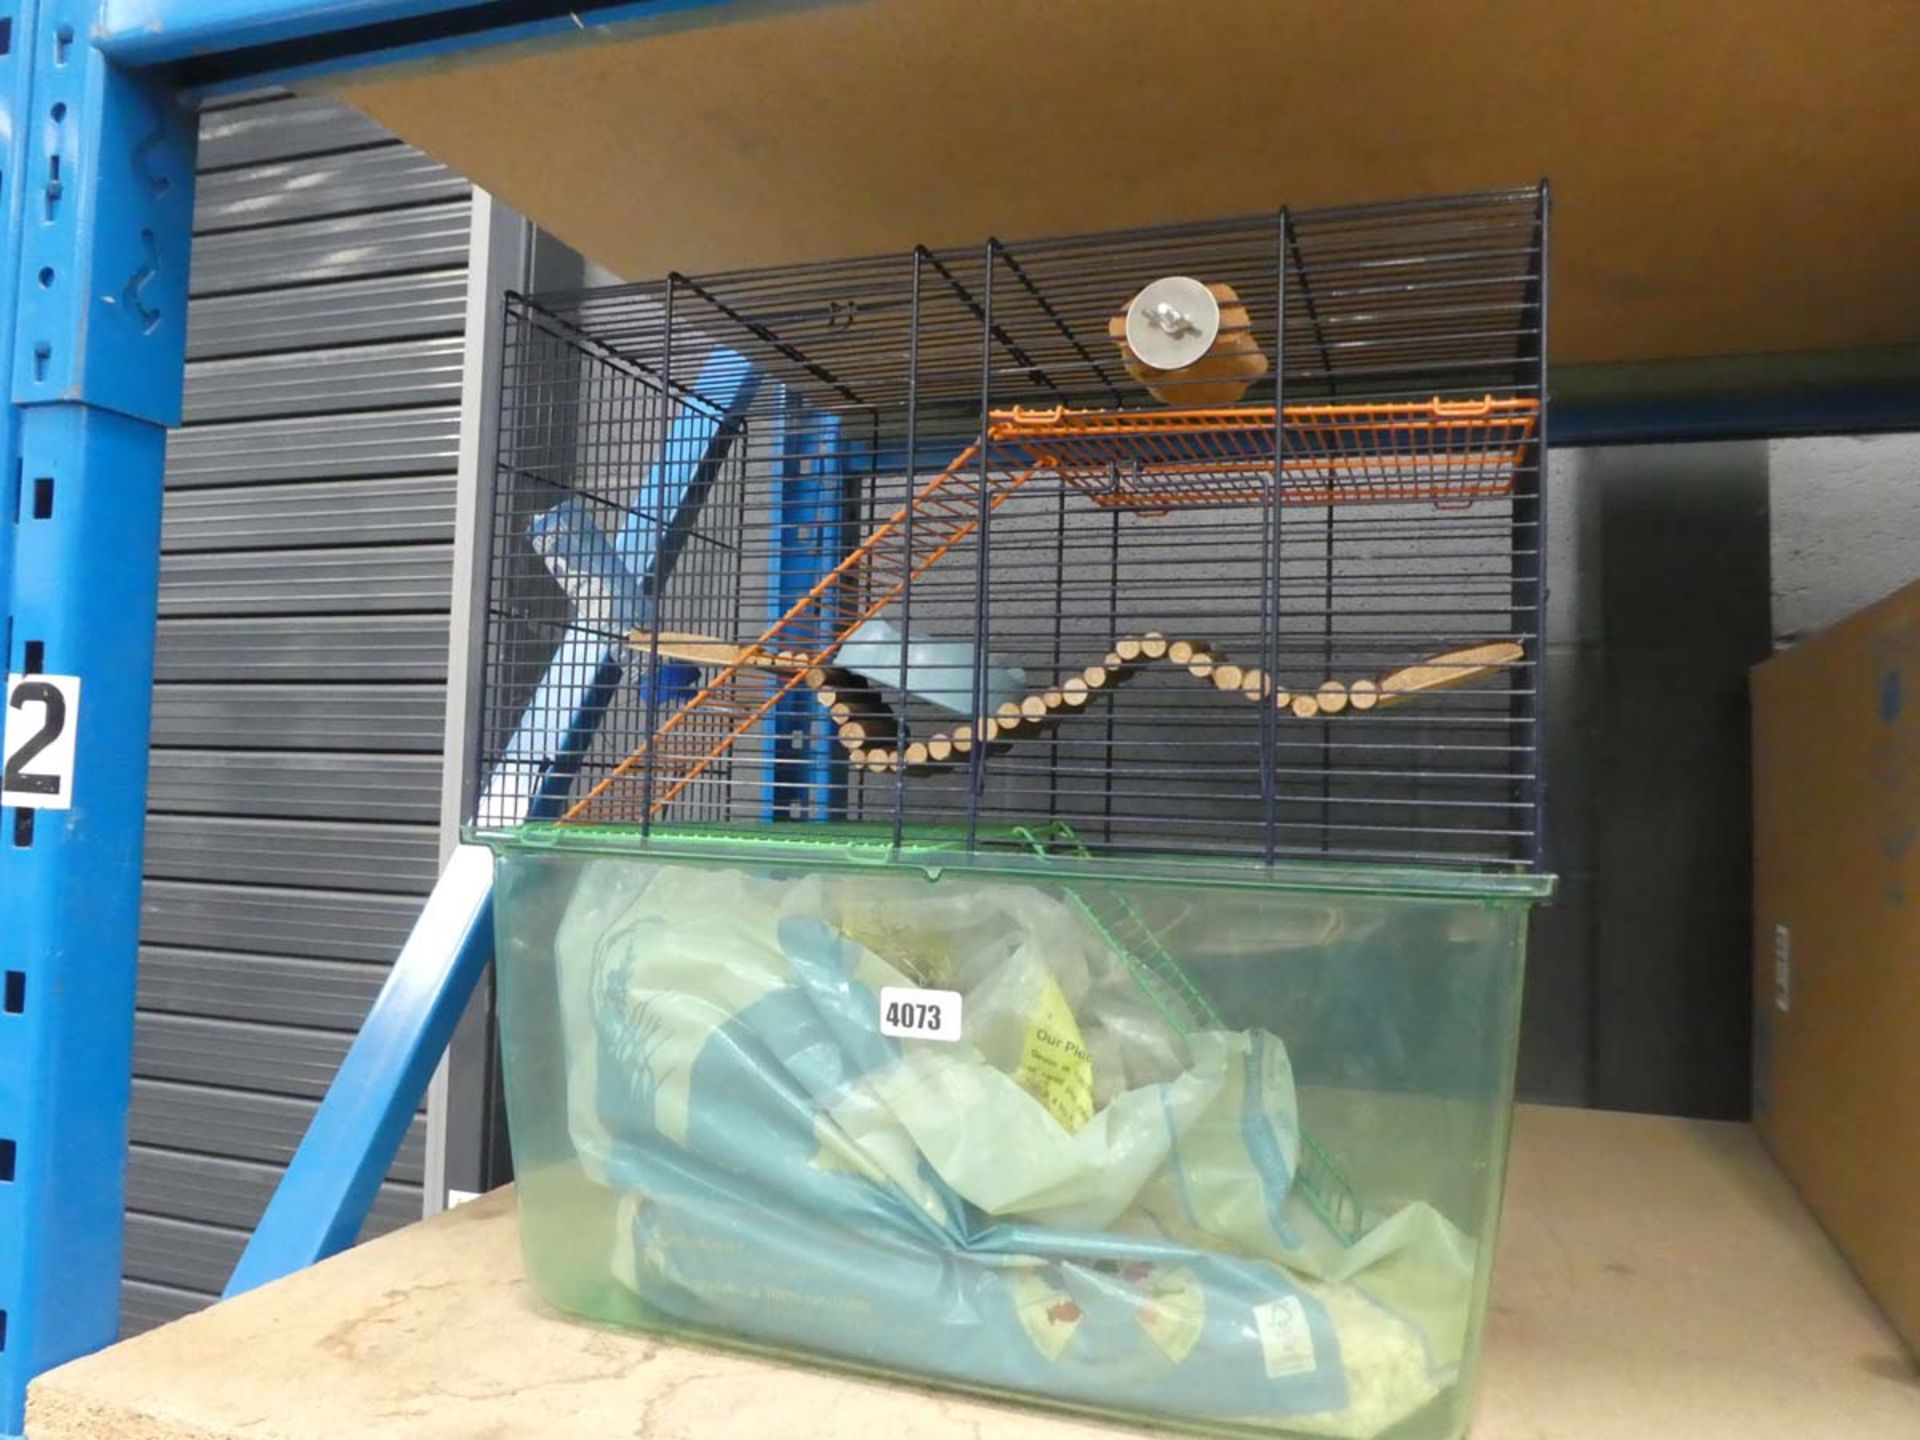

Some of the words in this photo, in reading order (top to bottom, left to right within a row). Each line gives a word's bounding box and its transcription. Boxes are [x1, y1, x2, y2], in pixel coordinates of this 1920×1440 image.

[4, 681, 66, 795] 2
[886, 1001, 942, 1031] 4073
[1036, 1028, 1063, 1048] Our
